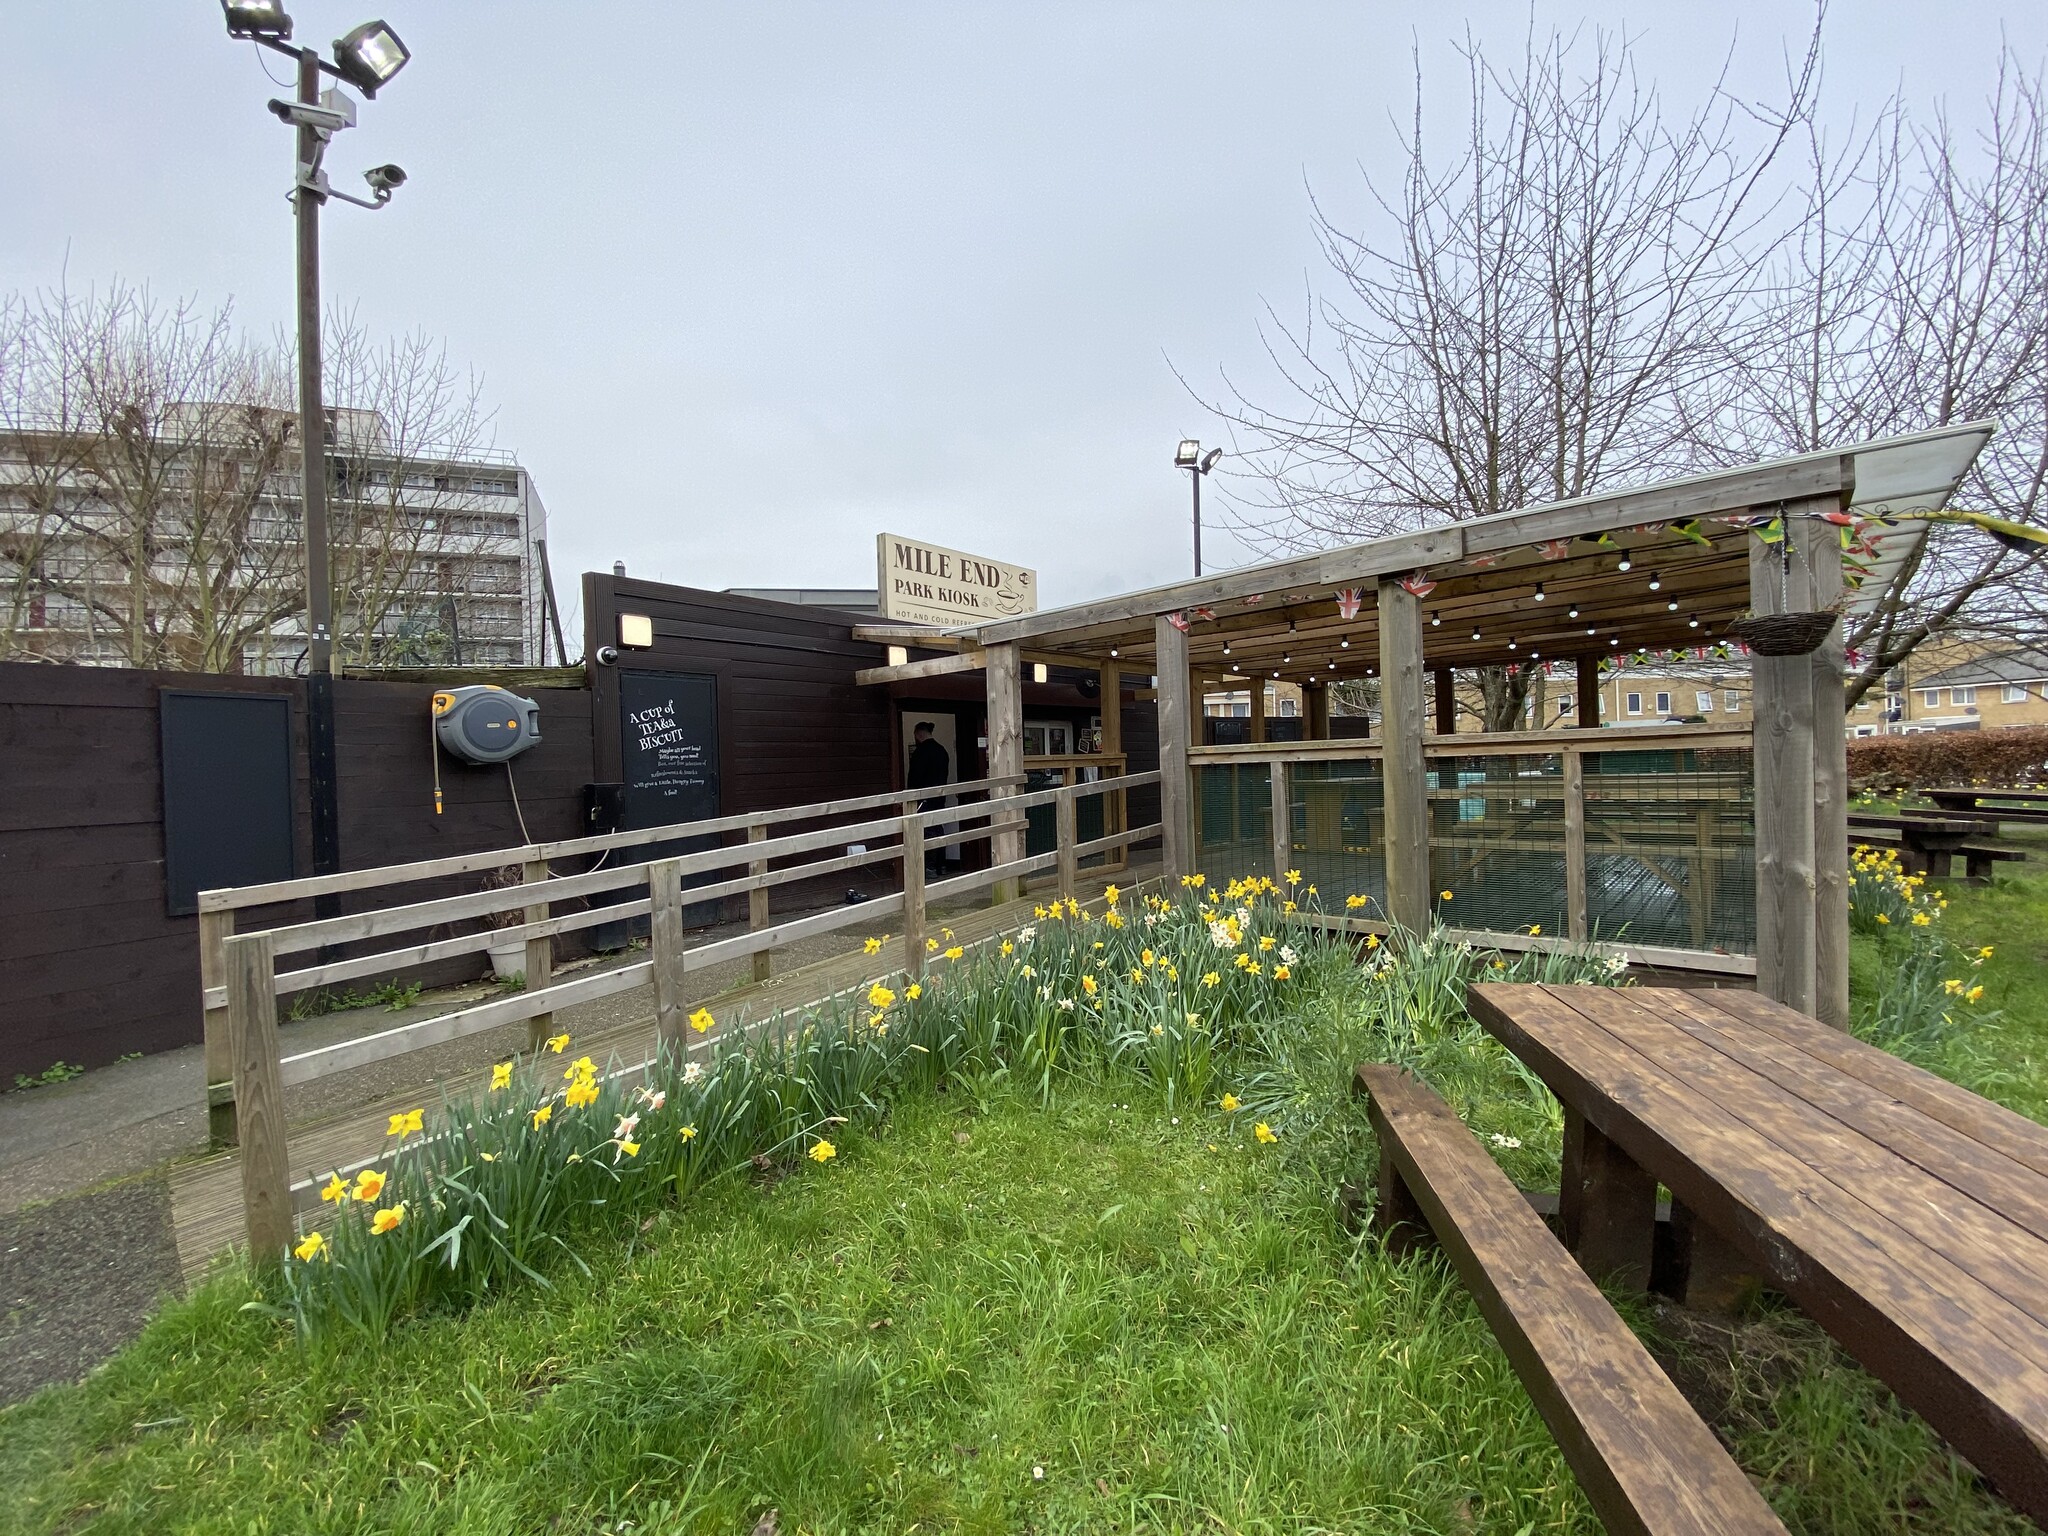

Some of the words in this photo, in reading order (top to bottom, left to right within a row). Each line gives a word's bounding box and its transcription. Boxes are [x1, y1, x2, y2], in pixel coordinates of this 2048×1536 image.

[894, 542, 952, 578] MILE
[960, 558, 1000, 588] END
[894, 578, 934, 600] PARK
[938, 586, 980, 608] KIOSK
[896, 610, 910, 618] HOT
[914, 612, 928, 621] AND
[931, 616, 950, 624] COLD
[630, 712, 640, 724] A
[640, 706, 663, 721] CUP
[664, 699, 676, 715] of
[638, 728, 684, 752] BISCUIT
